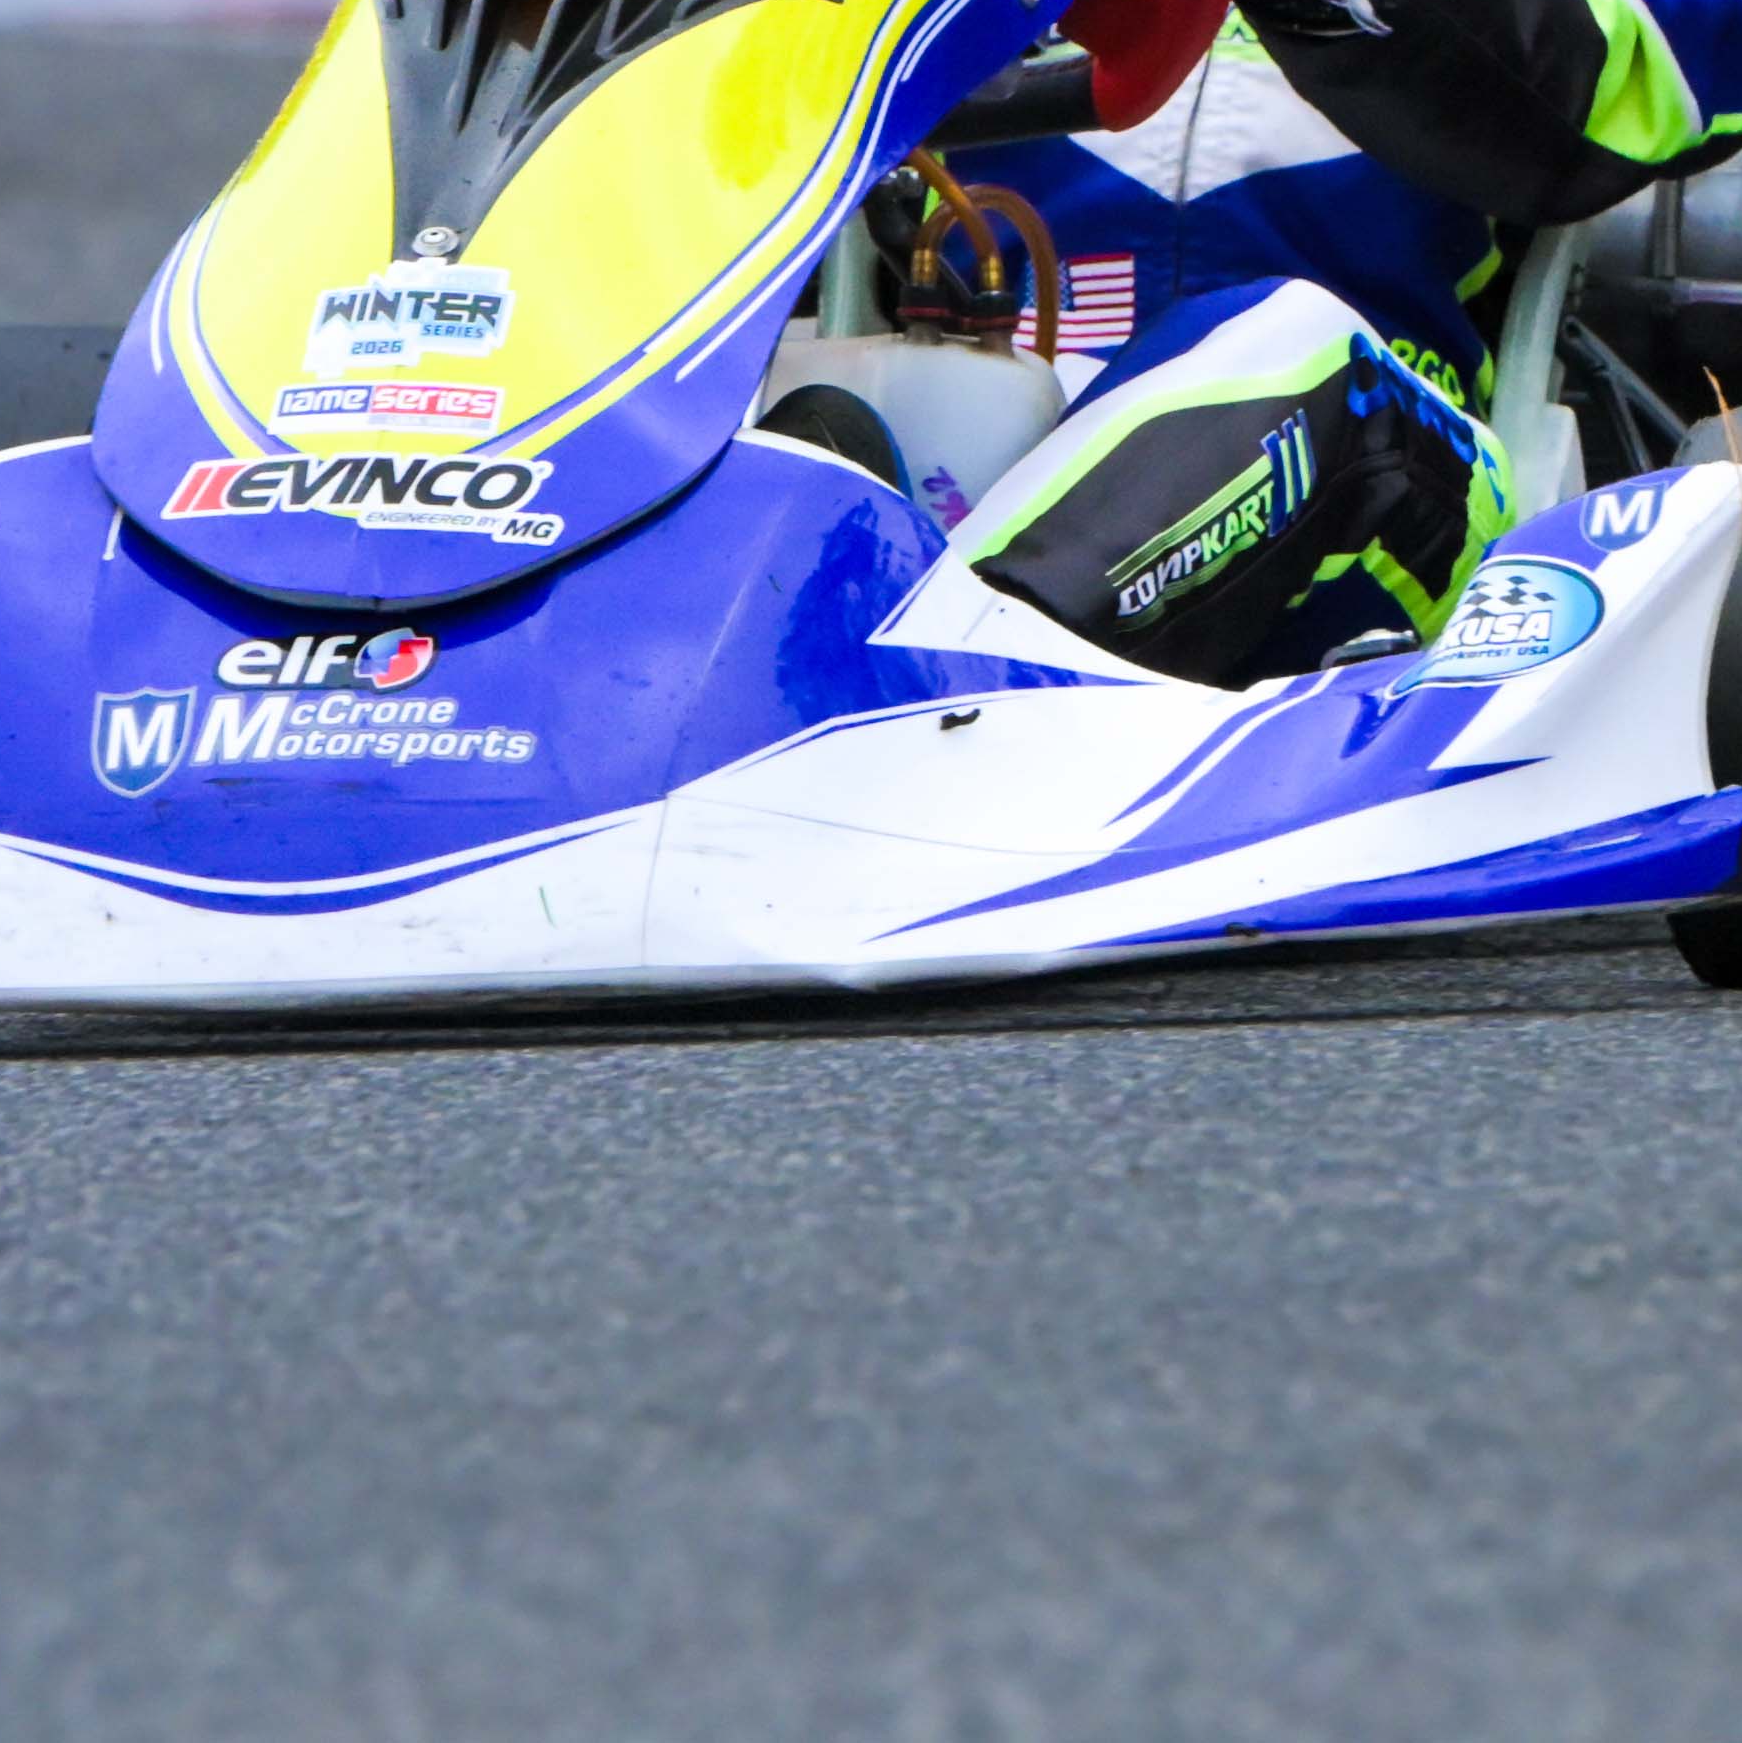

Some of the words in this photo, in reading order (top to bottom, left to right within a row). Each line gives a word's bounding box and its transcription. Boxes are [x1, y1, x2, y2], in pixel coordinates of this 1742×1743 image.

[322, 289, 503, 329] WINTER
[350, 339, 404, 355] 2026
[421, 323, 485, 339] SERIES
[225, 458, 536, 510] EVINCO
[364, 511, 474, 526] ENGINEERED
[477, 516, 503, 527] BY
[503, 518, 554, 538] MG
[1590, 489, 1655, 538] M
[219, 635, 358, 687] elf
[1517, 645, 1550, 656] USA
[106, 705, 175, 769] M
[196, 727, 534, 766] Motorsports
